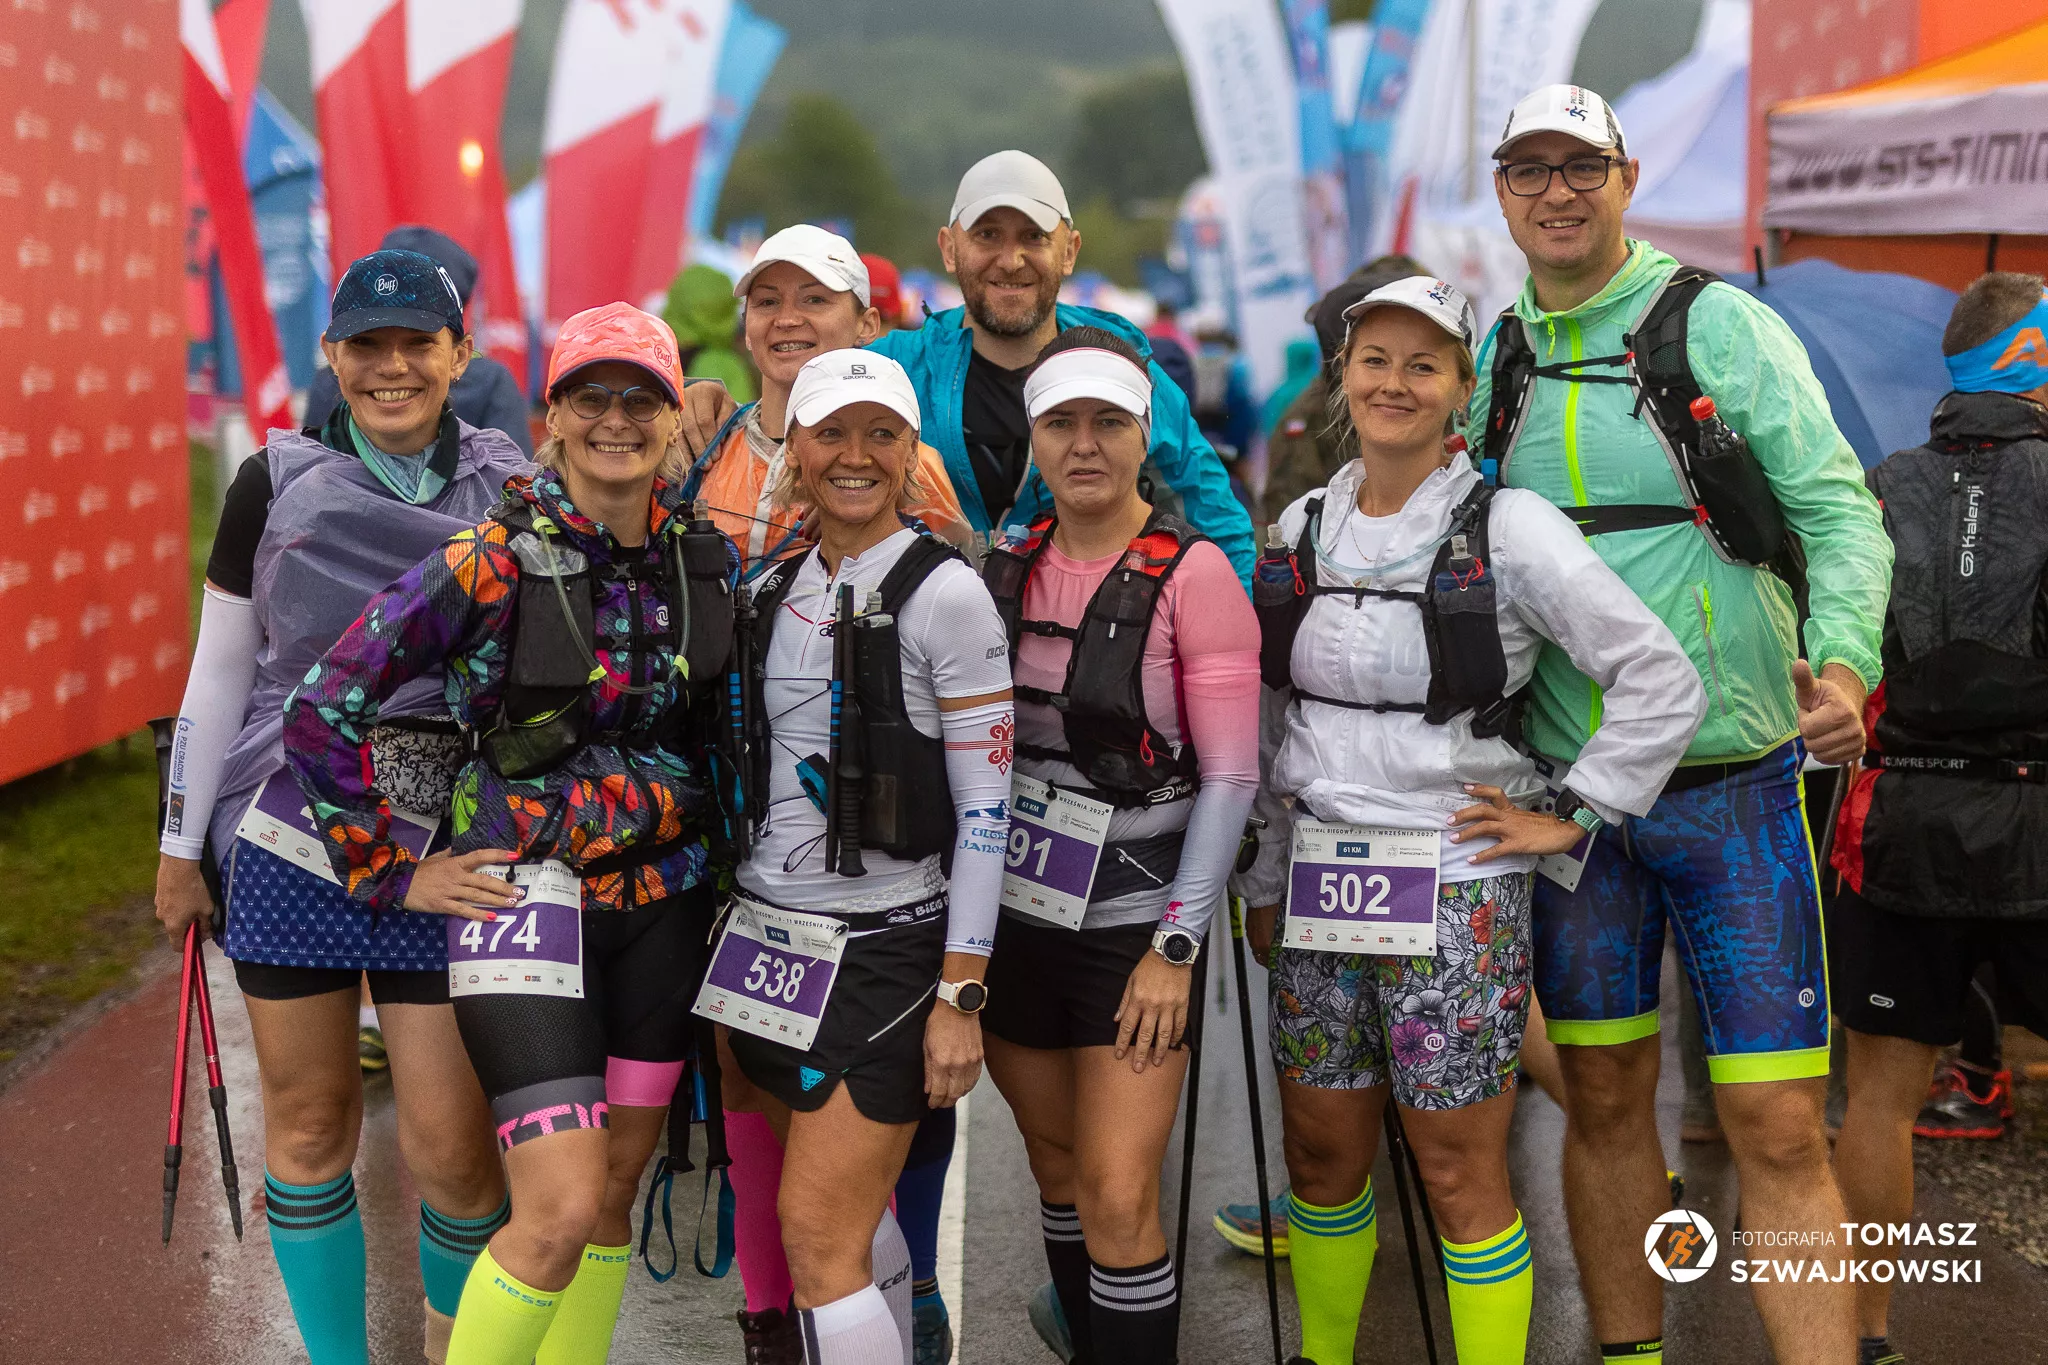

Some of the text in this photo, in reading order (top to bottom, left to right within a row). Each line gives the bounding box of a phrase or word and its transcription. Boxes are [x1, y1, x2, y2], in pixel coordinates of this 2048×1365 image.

[1351, 846, 1362, 854] KM
[1319, 872, 1391, 915] 502
[460, 911, 540, 953] 474
[744, 951, 805, 1003] 538
[494, 1277, 553, 1307] nessi
